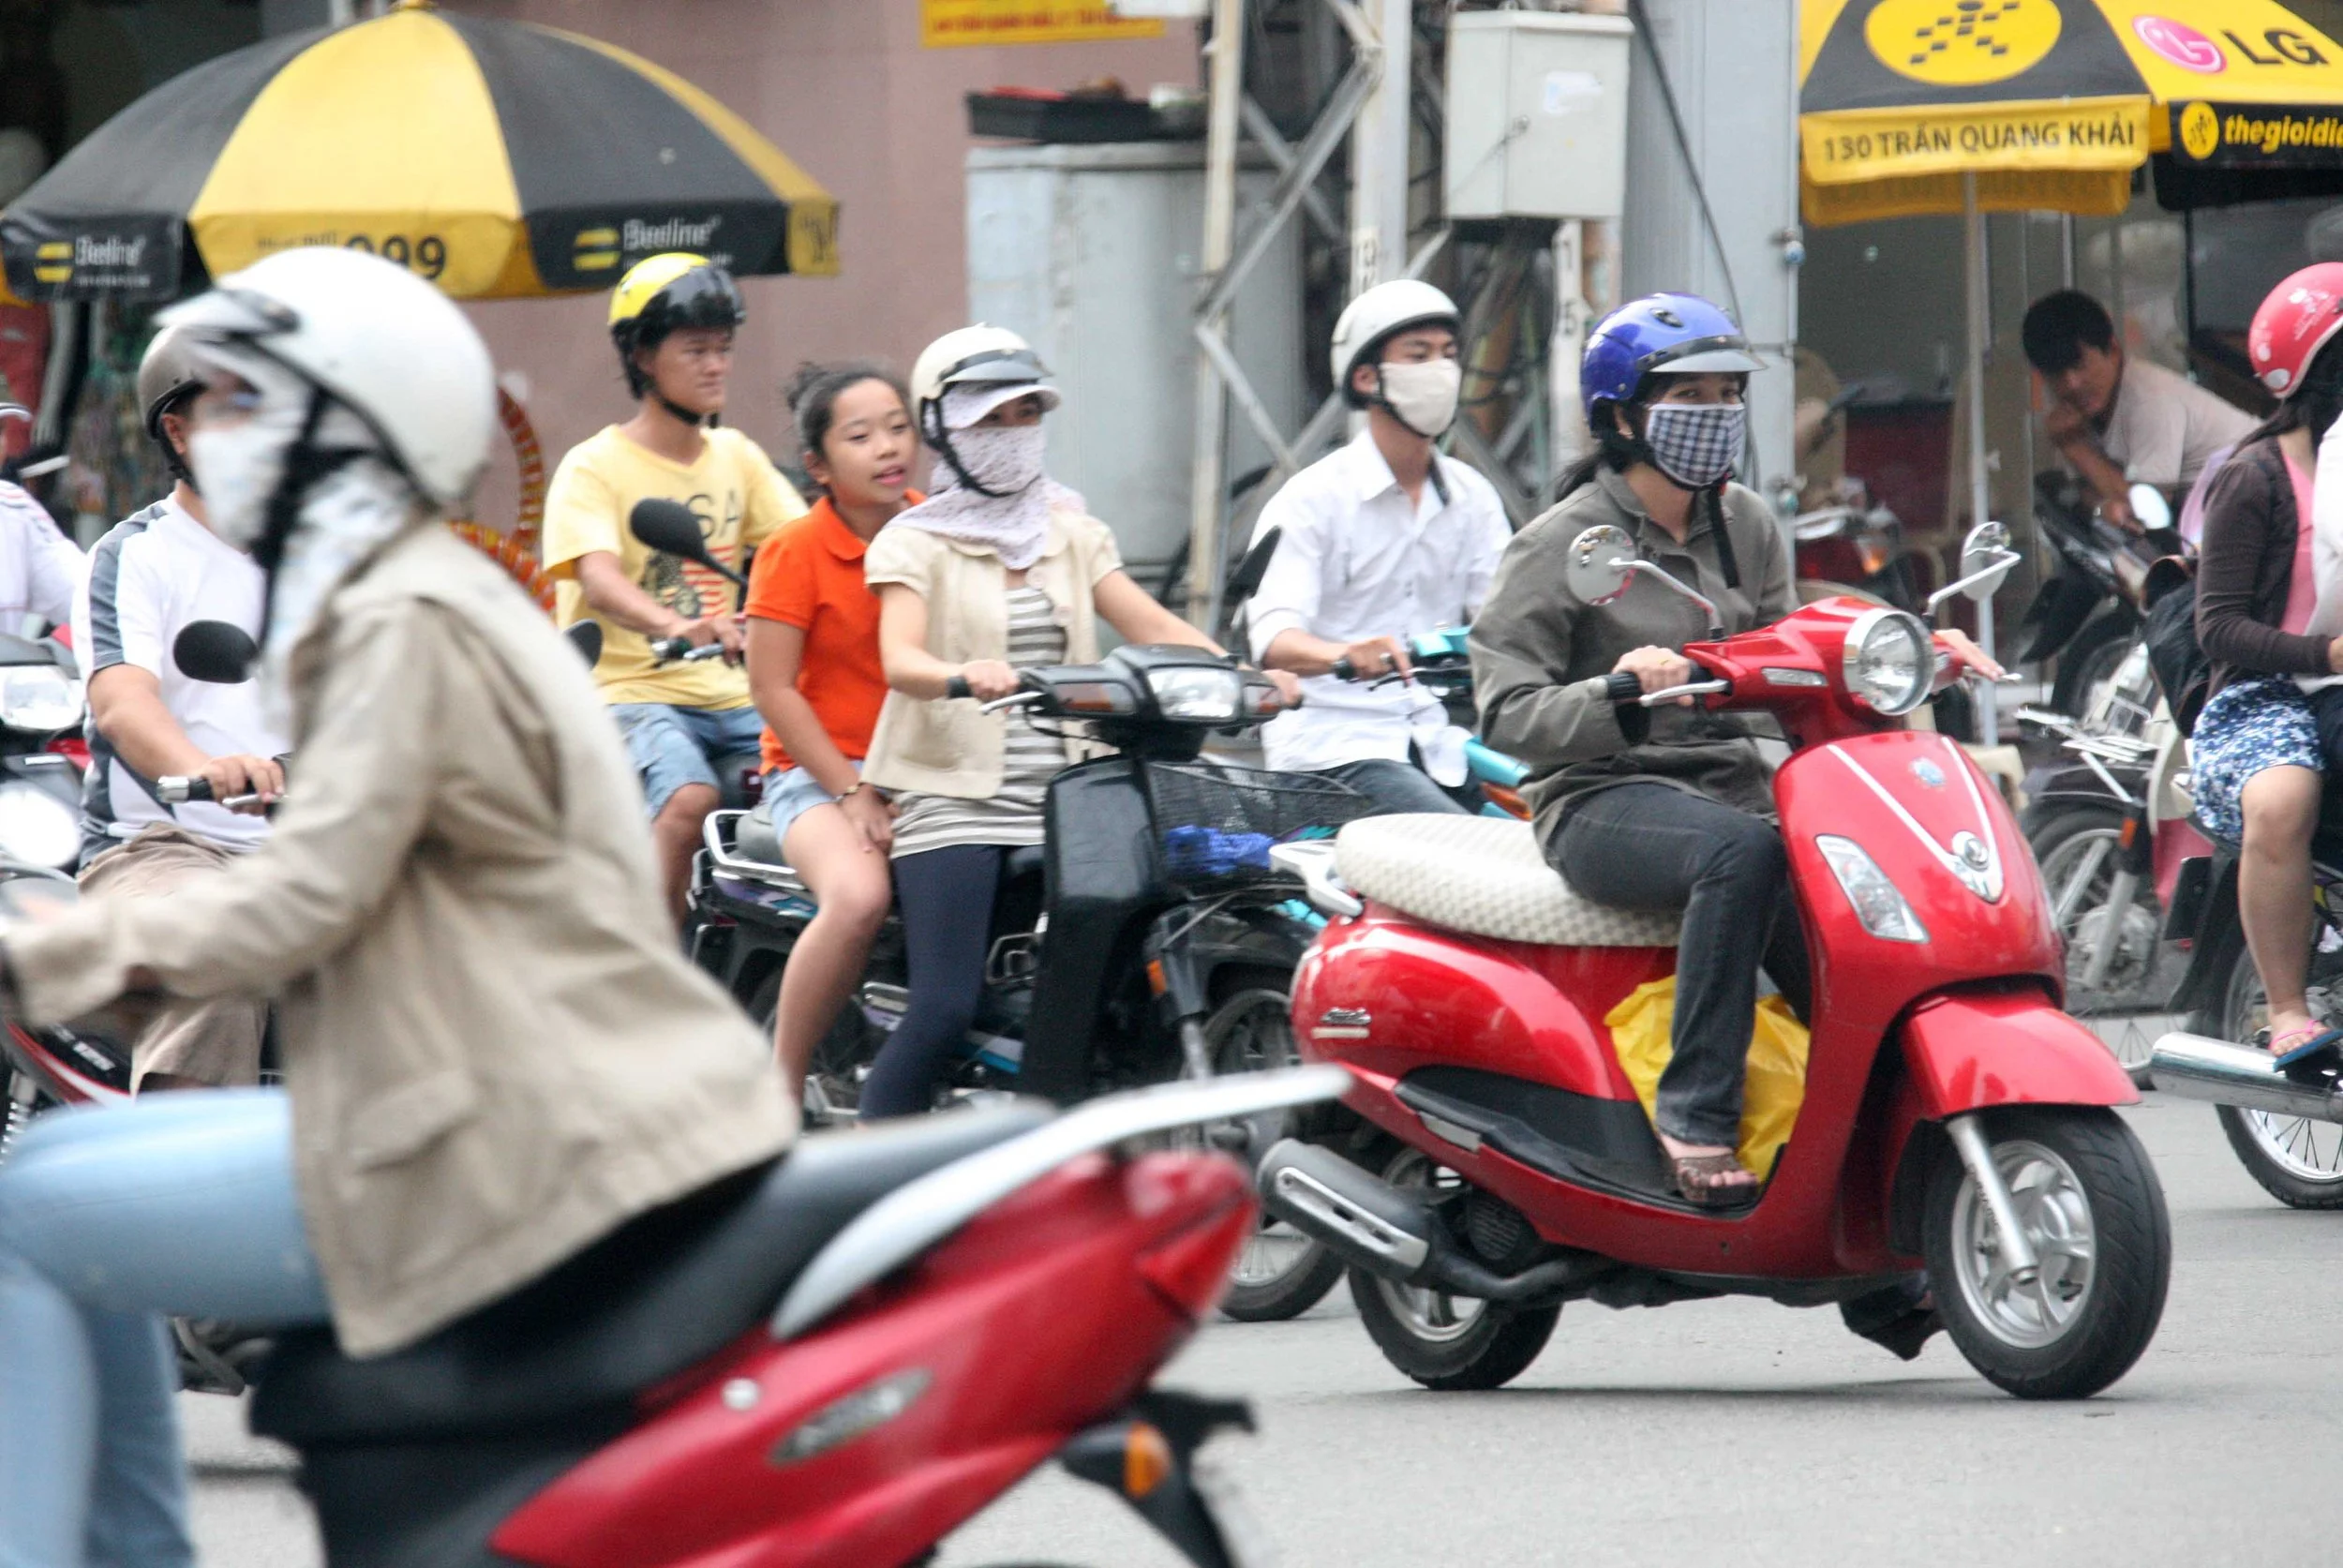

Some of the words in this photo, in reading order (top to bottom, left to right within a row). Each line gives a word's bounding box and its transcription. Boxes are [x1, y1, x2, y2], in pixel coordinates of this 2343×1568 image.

[2221, 27, 2330, 65] LG
[1825, 134, 1872, 161] 130
[1960, 122, 2062, 153] QUANG
